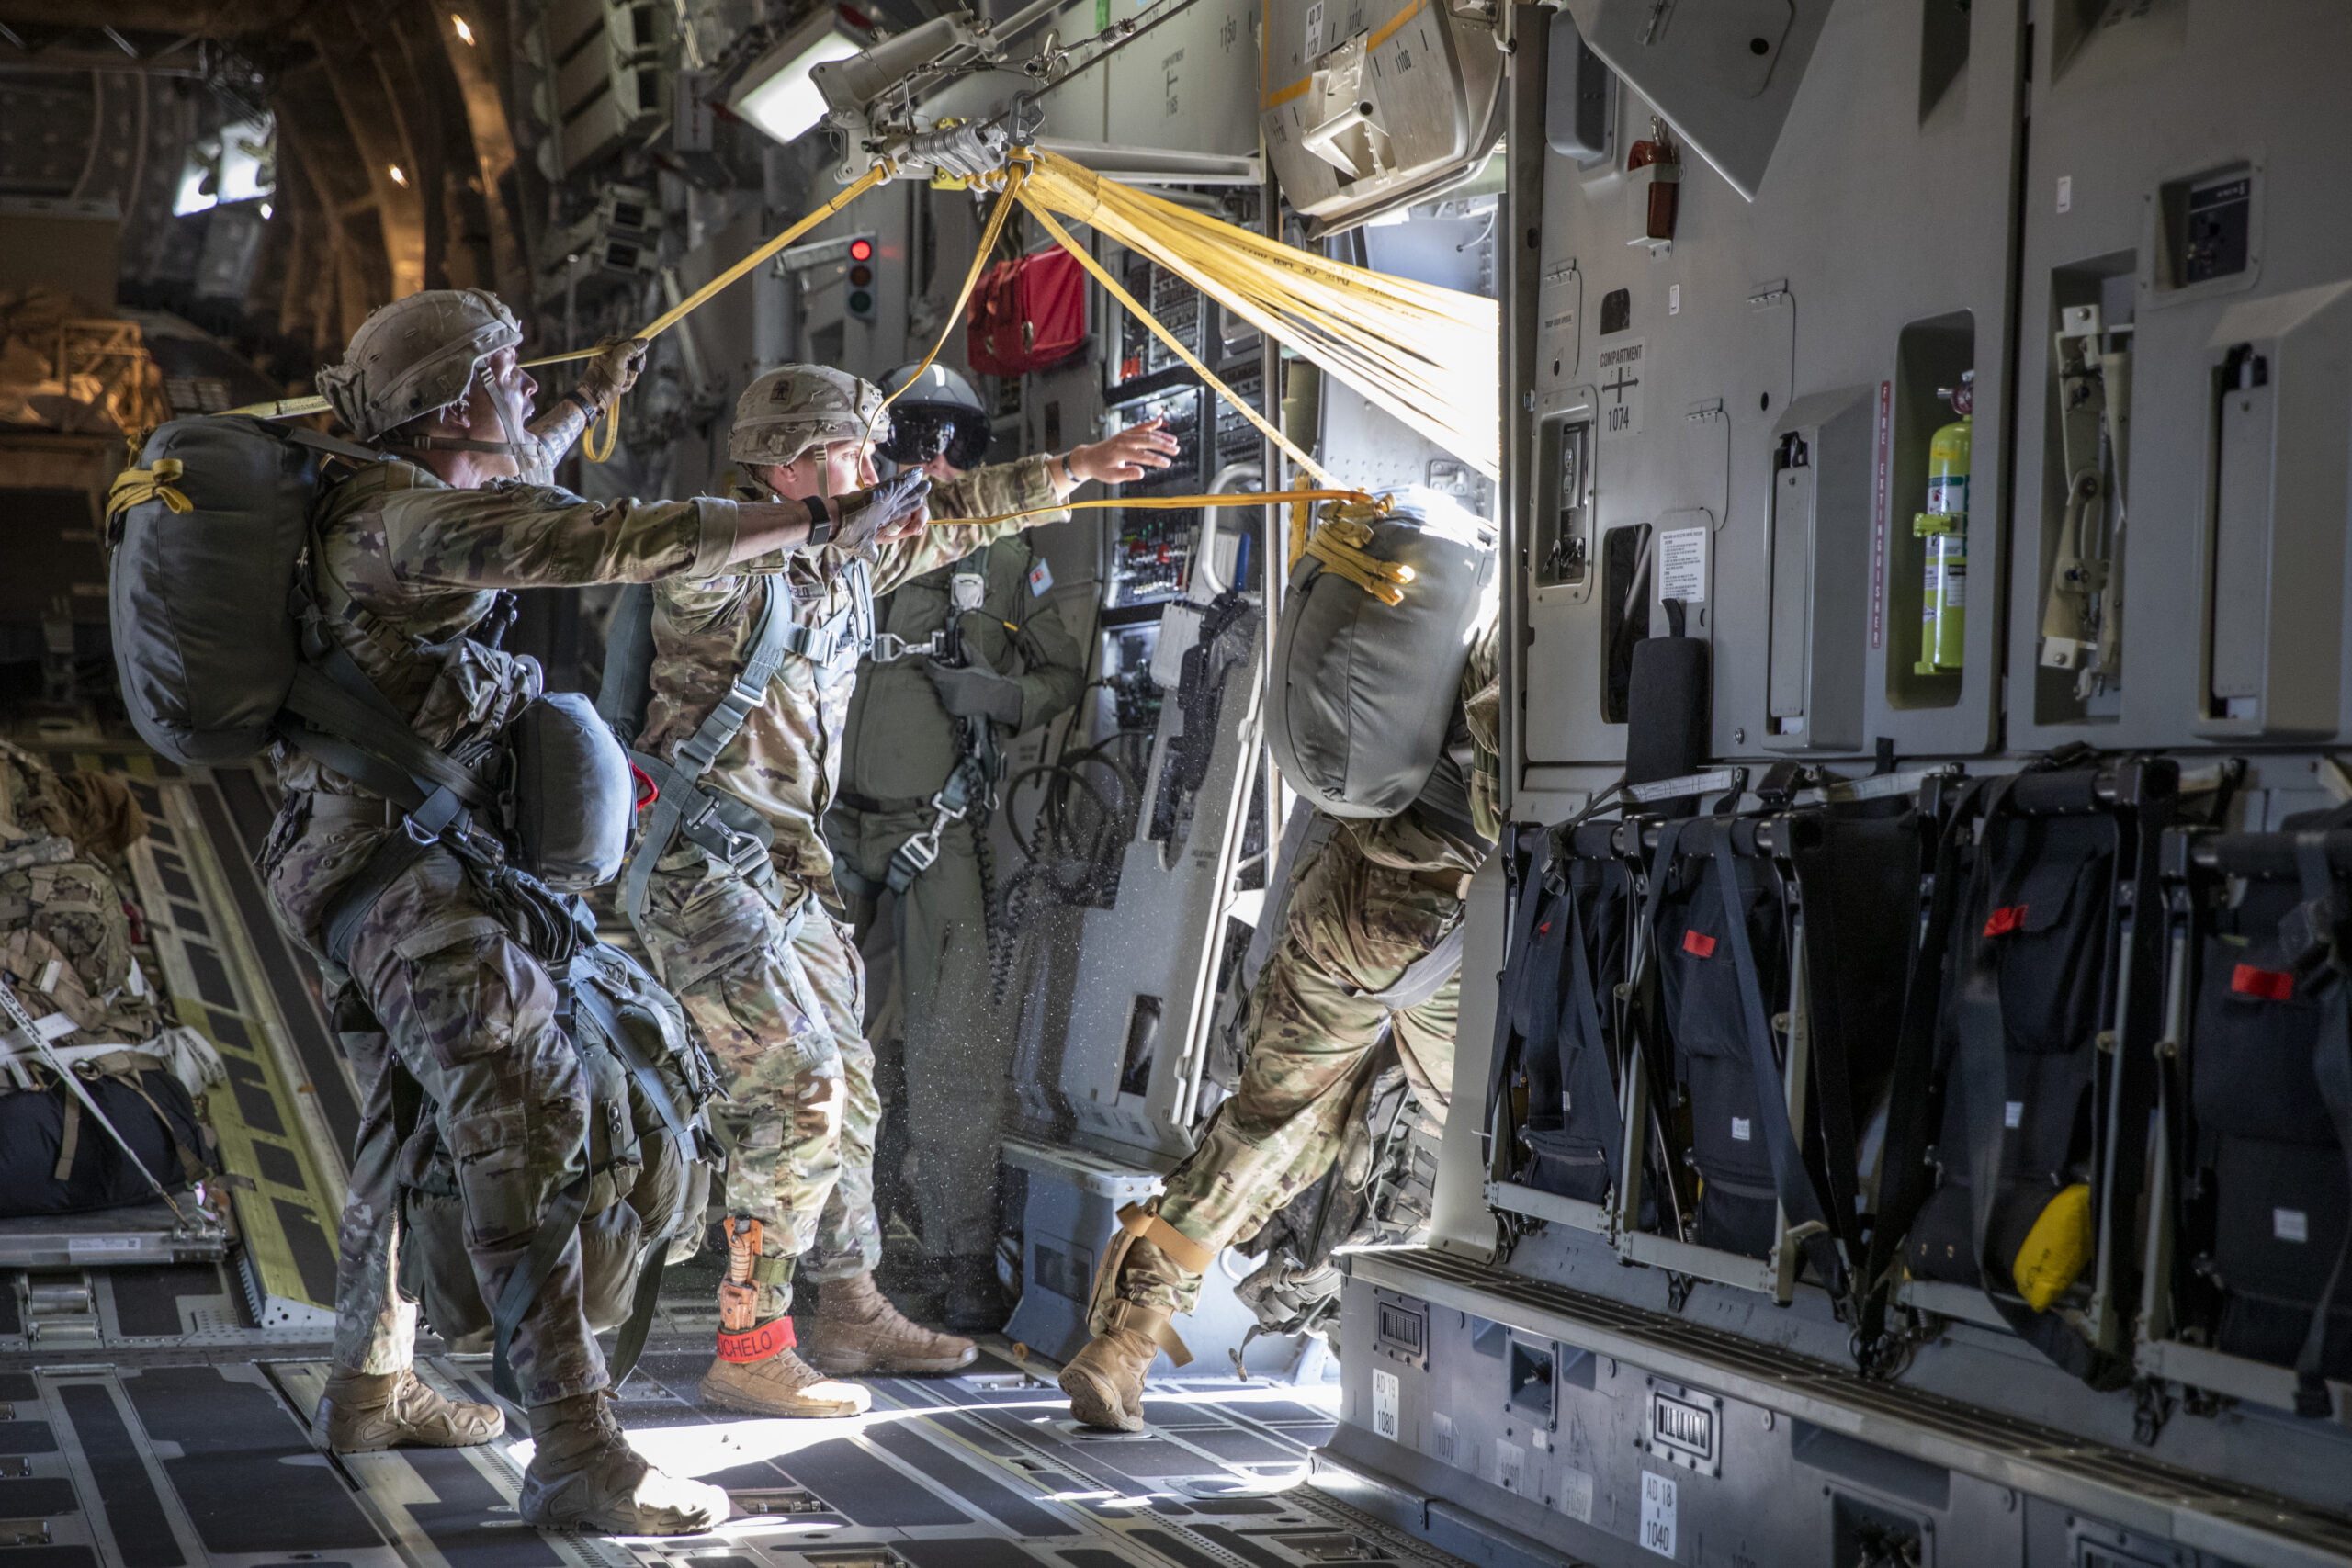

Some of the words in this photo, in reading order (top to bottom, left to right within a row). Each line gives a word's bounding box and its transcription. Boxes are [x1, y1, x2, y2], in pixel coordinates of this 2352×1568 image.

[1395, 50, 1412, 75] 1100
[1600, 344, 1643, 367] COMPARTMENT
[1609, 406, 1630, 432] 1074
[1881, 386, 1889, 445] FIRE
[1873, 462, 1885, 645] EXTINGUISHER
[1376, 1373, 1385, 1394] AD
[1387, 1378, 1396, 1399] 19
[1377, 1410, 1394, 1436] 1080
[1646, 1477, 1658, 1501] AD
[1662, 1483, 1672, 1507] 18
[1646, 1520, 1669, 1551] 1040
